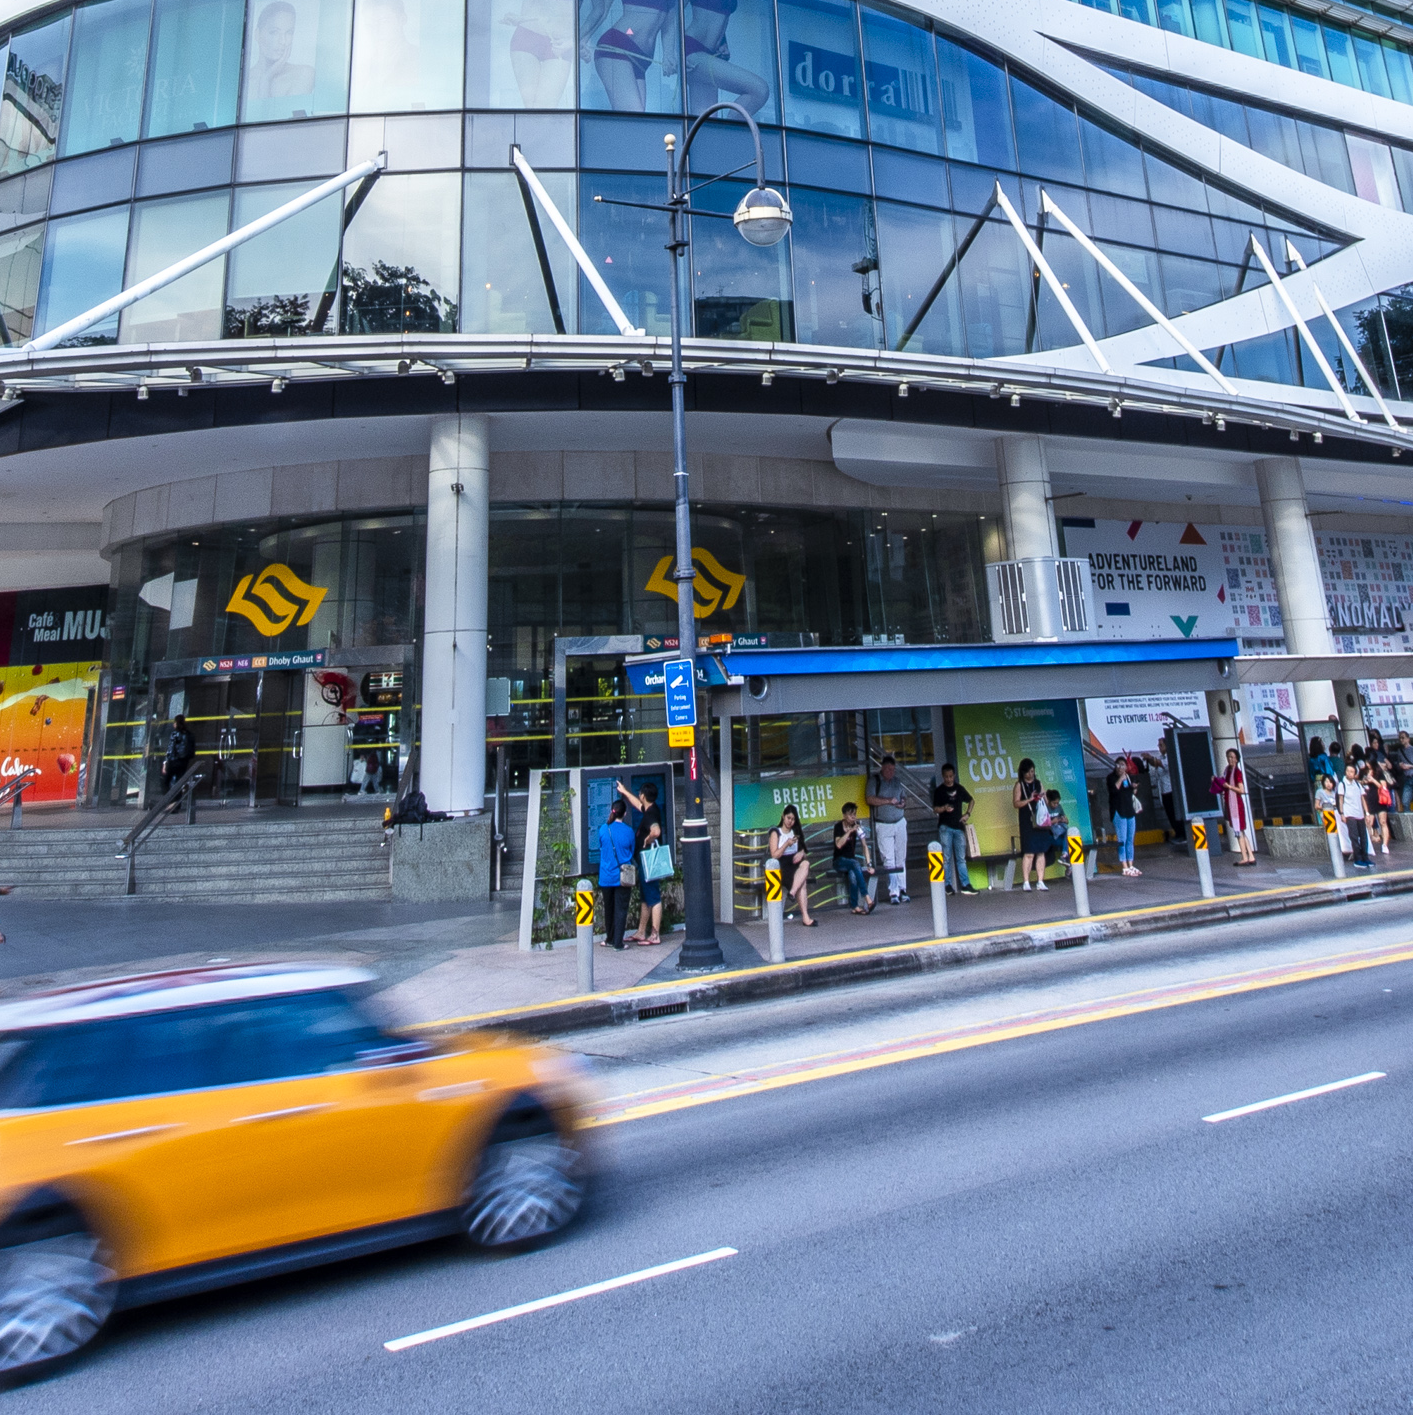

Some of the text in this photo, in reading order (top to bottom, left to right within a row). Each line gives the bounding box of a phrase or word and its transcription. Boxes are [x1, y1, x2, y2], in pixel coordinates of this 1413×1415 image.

[1088, 552, 1198, 573] ADVENTURELAND
[1118, 573, 1144, 591] THE
[1146, 574, 1207, 592] FORWARD
[28, 611, 54, 629] Café
[33, 627, 60, 643] Meal
[268, 655, 291, 666] Dhoby
[292, 654, 314, 664] Ghaut
[645, 674, 666, 686] Orchar
[1122, 713, 1147, 723] VENTURE
[964, 733, 1007, 757] FEEL
[969, 756, 1019, 782] COOL
[773, 784, 834, 804] BREATHE
